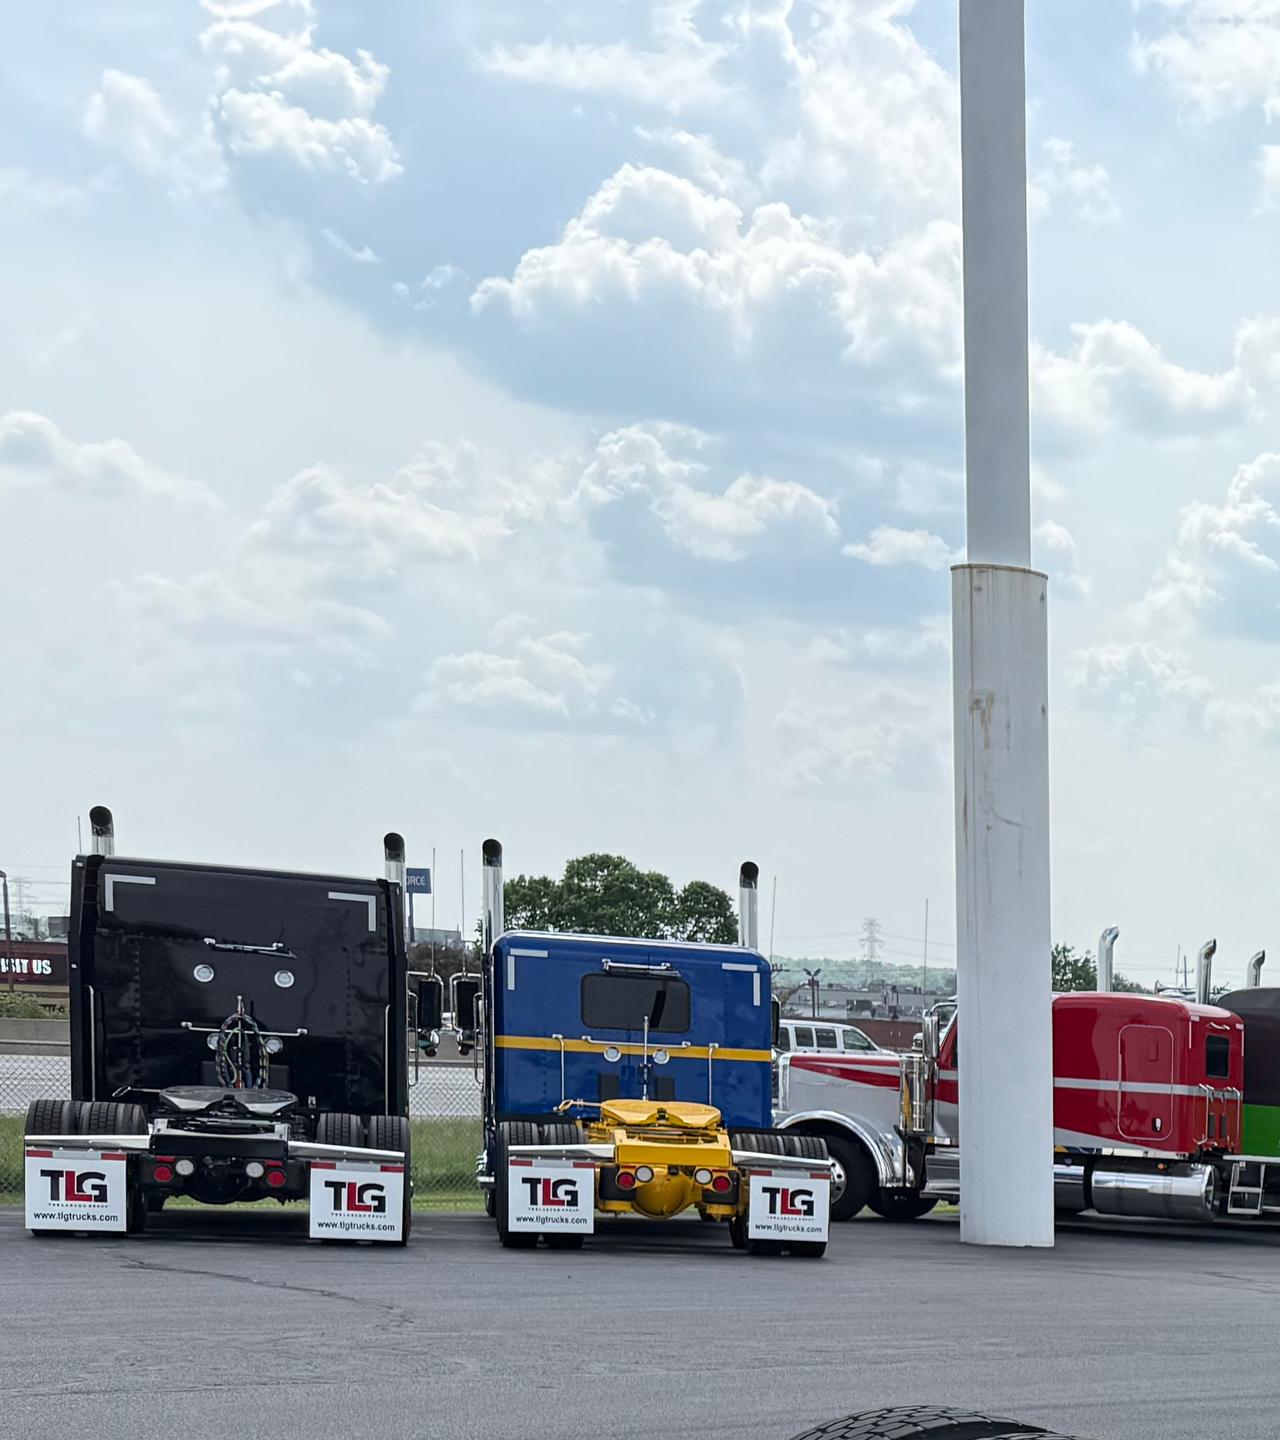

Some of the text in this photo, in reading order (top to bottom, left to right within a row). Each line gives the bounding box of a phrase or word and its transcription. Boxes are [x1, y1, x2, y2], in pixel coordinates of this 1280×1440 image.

[32, 959, 52, 975] US
[40, 1169, 108, 1203] TLG
[521, 1177, 579, 1207] TLG
[324, 1181, 386, 1213] TLG
[761, 1186, 815, 1217] TLG
[33, 1211, 119, 1223] www.tlgtrucks.com
[515, 1215, 588, 1225] www.tlgtrucks.com
[317, 1220, 396, 1233] www.tlgtrucks.com
[755, 1223, 822, 1233] www.tlgtrucks.com
